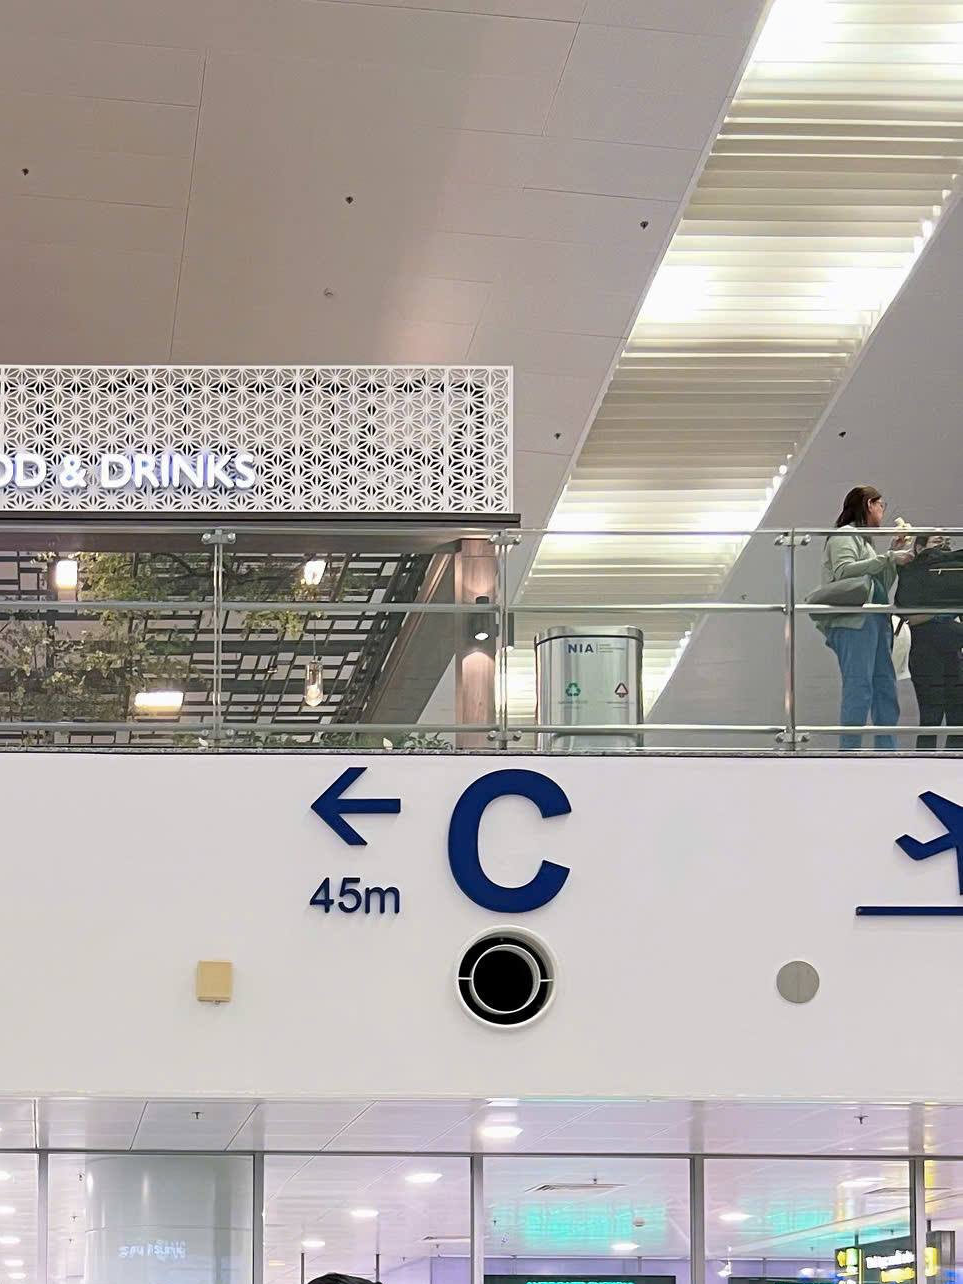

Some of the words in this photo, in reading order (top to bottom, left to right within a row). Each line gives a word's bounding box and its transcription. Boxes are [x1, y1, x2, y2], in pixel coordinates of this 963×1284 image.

[59, 454, 87, 489] &
[100, 453, 256, 489] DRINKS
[568, 643, 594, 654] NIA
[448, 768, 572, 913] C
[309, 877, 400, 914] 45m
